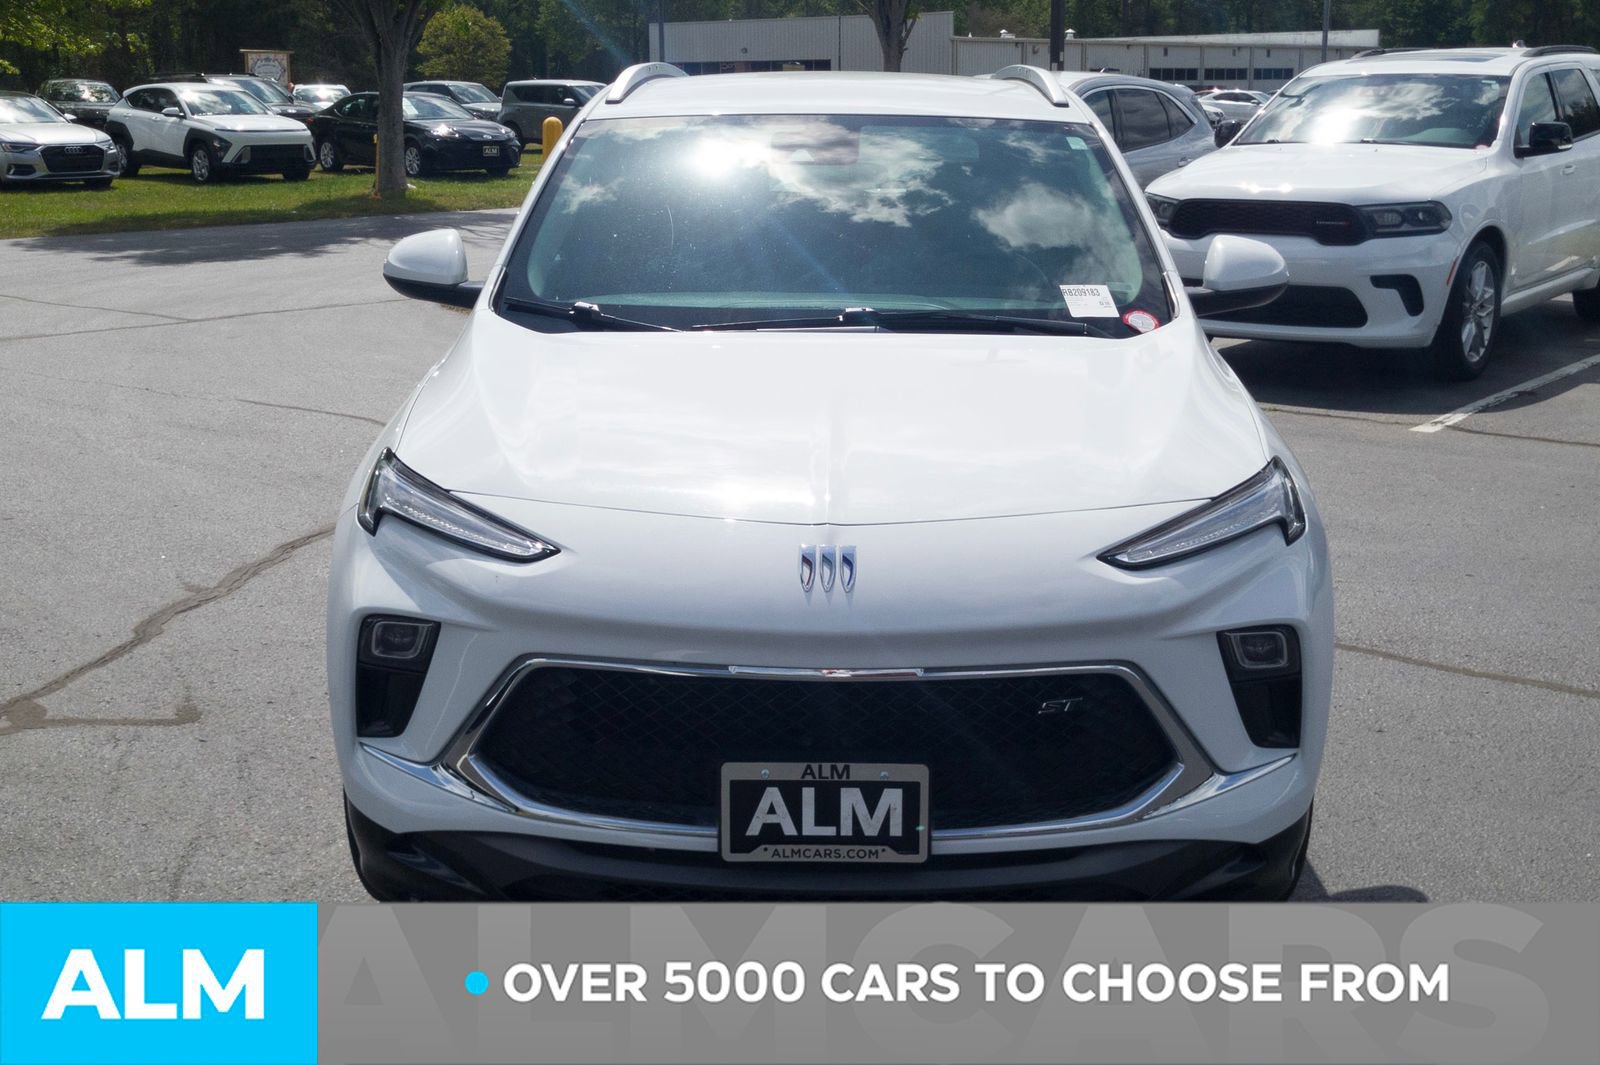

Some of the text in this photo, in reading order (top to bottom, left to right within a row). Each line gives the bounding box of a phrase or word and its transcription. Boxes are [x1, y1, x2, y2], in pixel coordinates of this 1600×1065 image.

[1037, 696, 1083, 715] ST
[800, 763, 851, 780] ALM
[745, 786, 904, 837] ALM
[771, 847, 880, 860] ALMCARS.COM
